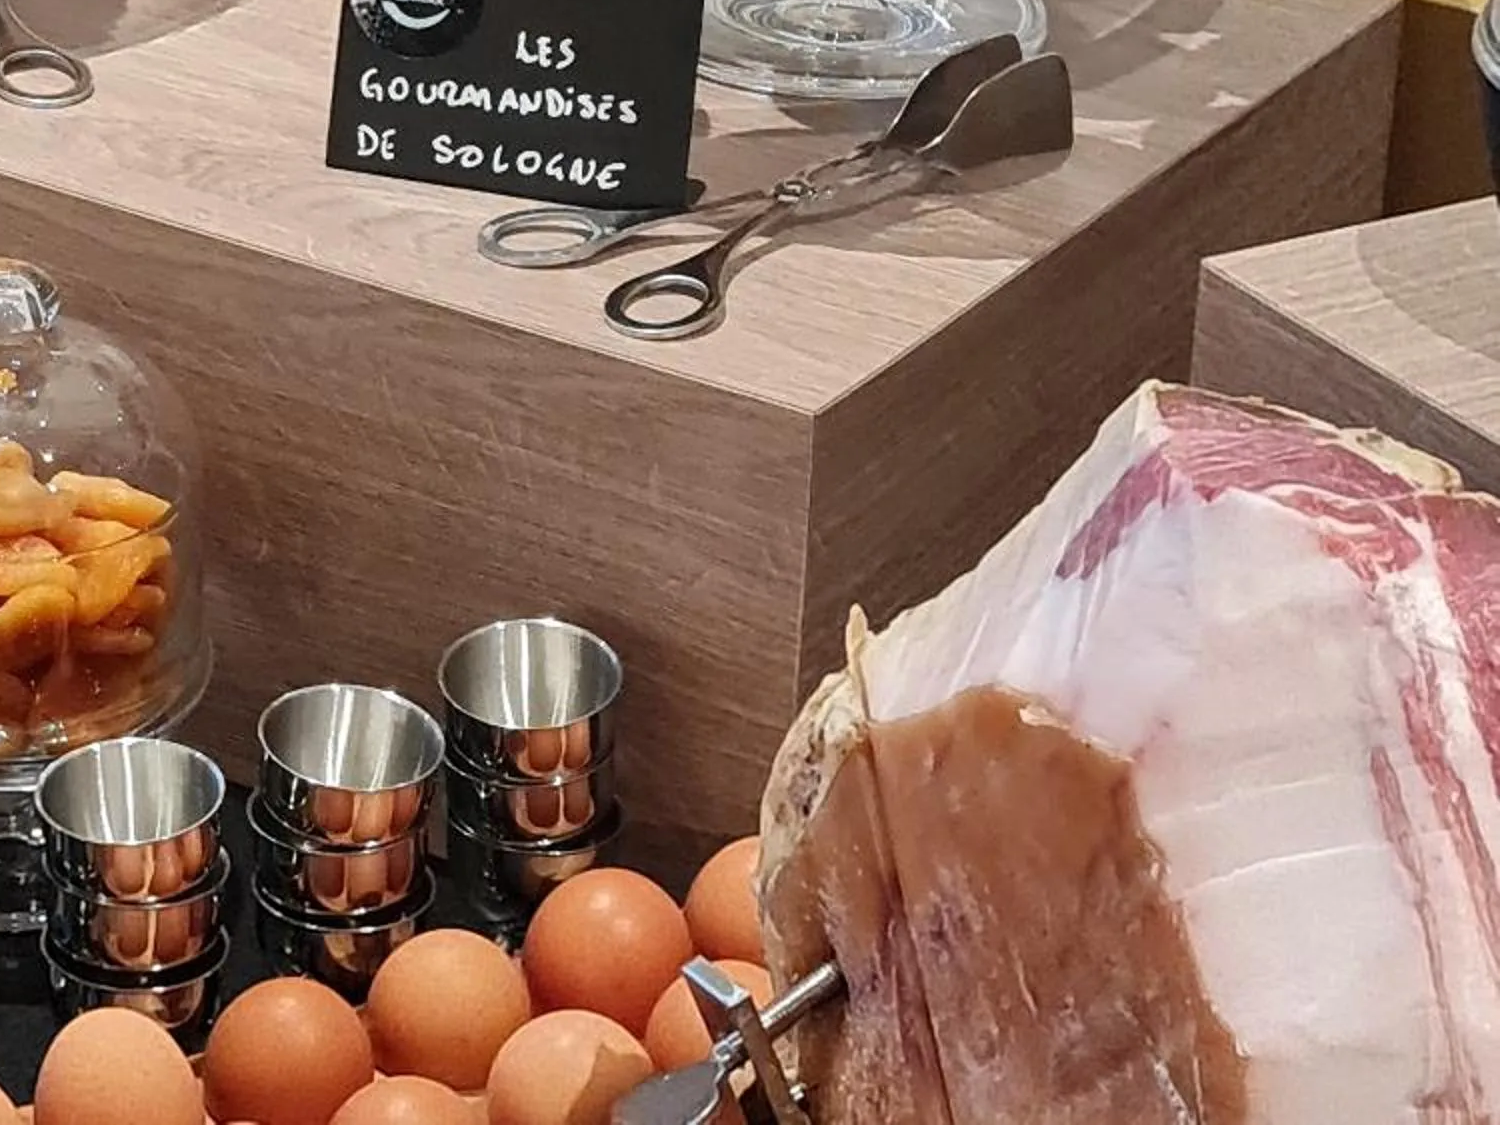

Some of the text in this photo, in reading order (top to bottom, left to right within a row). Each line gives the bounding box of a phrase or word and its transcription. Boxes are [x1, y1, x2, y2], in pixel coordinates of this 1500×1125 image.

[515, 31, 576, 70] LES
[359, 68, 639, 124] GOURMANDISES
[357, 124, 627, 190] DE SOLOGNE
